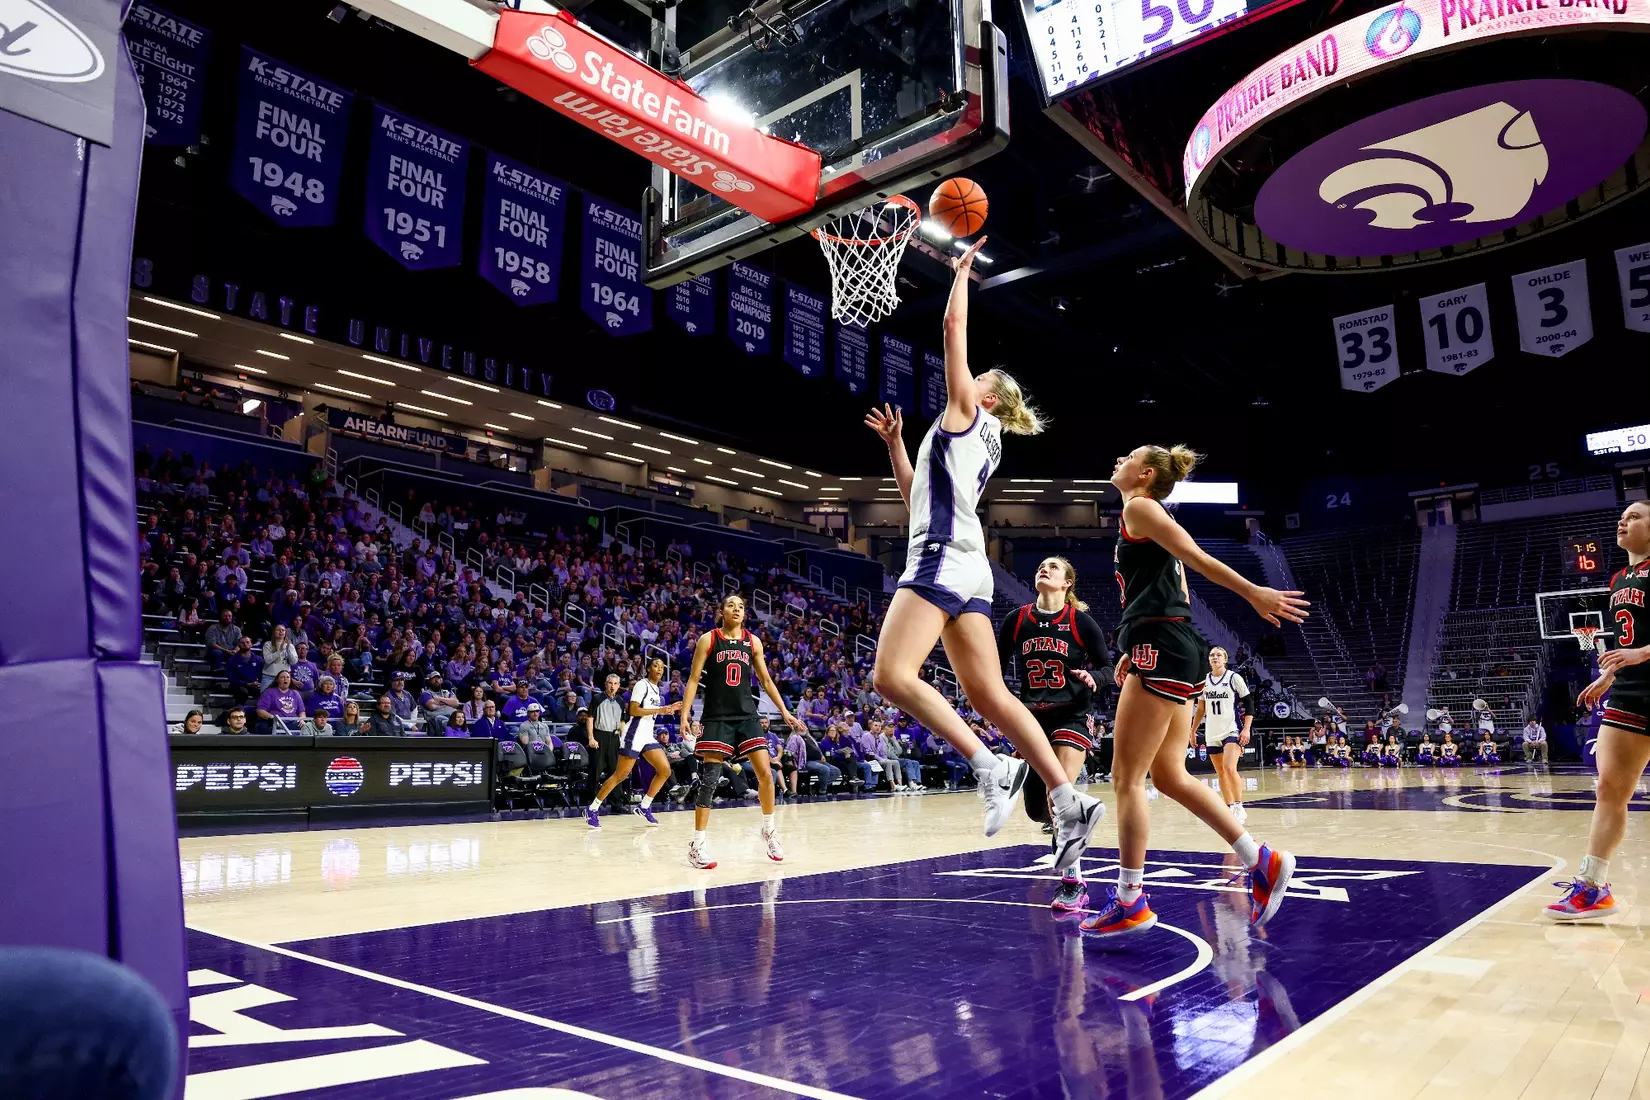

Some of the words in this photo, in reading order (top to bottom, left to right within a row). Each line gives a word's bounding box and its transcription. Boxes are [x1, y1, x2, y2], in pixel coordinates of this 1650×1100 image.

[130, 4, 204, 44] -STATE
[1048, 26, 1054, 35] 0
[1071, 15, 1077, 23] 4
[1095, 4, 1102, 13] 0
[1050, 38, 1056, 46] 4
[1071, 27, 1081, 38] 11
[1097, 17, 1103, 26] 3
[143, 38, 168, 54] NCAA
[145, 23, 196, 49] BASKETBALL
[1052, 50, 1057, 60] 5
[1075, 40, 1081, 49] 2
[1099, 29, 1105, 39] 2
[129, 40, 151, 59] ITE
[153, 51, 195, 76] EIGHT
[1051, 62, 1061, 72] 11
[1077, 52, 1083, 61] 6
[1102, 42, 1106, 50] 1
[1053, 73, 1064, 85] 34
[1076, 63, 1088, 75] 16
[1104, 55, 1108, 63] 1
[158, 83, 186, 101] 1972
[160, 71, 188, 90] 1964
[248, 56, 344, 109] K-STATE
[255, 74, 282, 91] MEN'S
[284, 86, 336, 114] BASKETBALL
[1215, 73, 1276, 143] PRAIRIE
[1280, 34, 1339, 90] BAND
[156, 107, 183, 125] 1975
[157, 95, 185, 113] 1973
[258, 100, 326, 145] FINAL
[381, 114, 461, 158] K-STATE
[256, 120, 323, 163] FOUR
[386, 131, 410, 145] MEN'S
[410, 140, 455, 163] BASKETBALL
[249, 157, 325, 204] 1948
[389, 154, 447, 192] FINAL
[492, 161, 561, 201] K-STATE
[387, 172, 444, 209] FOUR
[497, 176, 518, 190] MEN'S
[518, 185, 556, 206] BASKETBALL
[384, 208, 446, 248] 1951
[500, 198, 549, 232] FINAL
[499, 215, 547, 248] FOUR
[495, 247, 551, 284] 1958
[595, 237, 639, 268] FINAL
[594, 253, 637, 282] FOUR
[732, 262, 770, 286] K-STATE
[1527, 270, 1571, 287] OHLDE
[591, 282, 640, 317] 1964
[731, 291, 771, 313] CONFERENCE
[740, 285, 753, 297] BIG
[754, 290, 763, 301] 12
[789, 288, 823, 311] K-STATE
[1437, 293, 1468, 309] GARY
[1537, 287, 1569, 328] 3
[730, 299, 771, 323] CHAMPIONS
[1339, 312, 1389, 331] ROMSTAD
[191, 274, 317, 334] STATE
[349, 318, 552, 396] UNIVERSITY
[736, 317, 765, 340] 2019
[1428, 306, 1484, 351] 10
[1535, 329, 1578, 345] 2000-04
[883, 335, 913, 354] K-STATE
[1341, 326, 1392, 369] 33
[1440, 349, 1479, 364] 1981-83
[1351, 368, 1386, 381] 1979-82
[1627, 433, 1647, 447] 50
[1529, 462, 1560, 480] 25
[1326, 492, 1352, 509] 24
[1573, 543, 1596, 553] 7:15
[1579, 555, 1596, 570] 16
[1615, 609, 1635, 647] 3
[716, 649, 750, 666] UTAH
[1022, 636, 1069, 657] UTAH
[726, 662, 742, 687] 0
[1026, 659, 1066, 689] 23
[1205, 690, 1229, 699] Wildcats
[1211, 700, 1222, 715] 11
[175, 762, 296, 791] PEPSI
[389, 761, 483, 787] PEPSI
